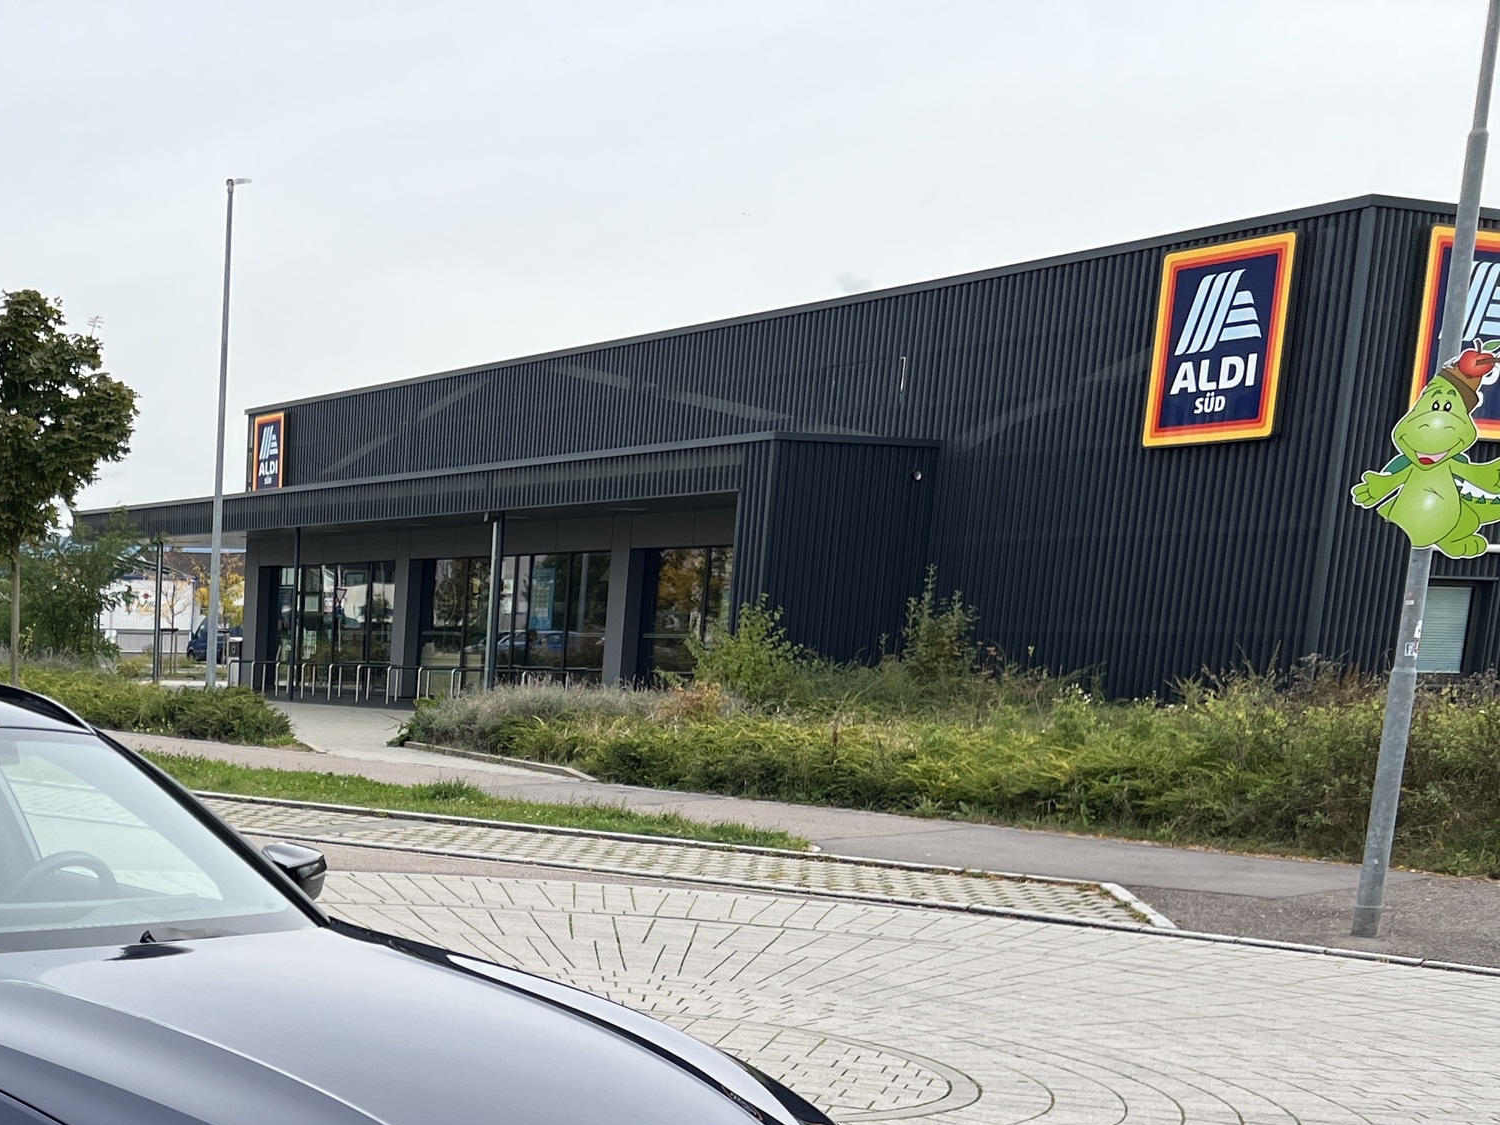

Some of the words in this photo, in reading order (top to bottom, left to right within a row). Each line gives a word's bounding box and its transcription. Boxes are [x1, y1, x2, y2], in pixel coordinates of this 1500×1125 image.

[1169, 353, 1258, 395] ALDI
[1193, 392, 1226, 415] SÜD
[258, 460, 279, 477] ALDI
